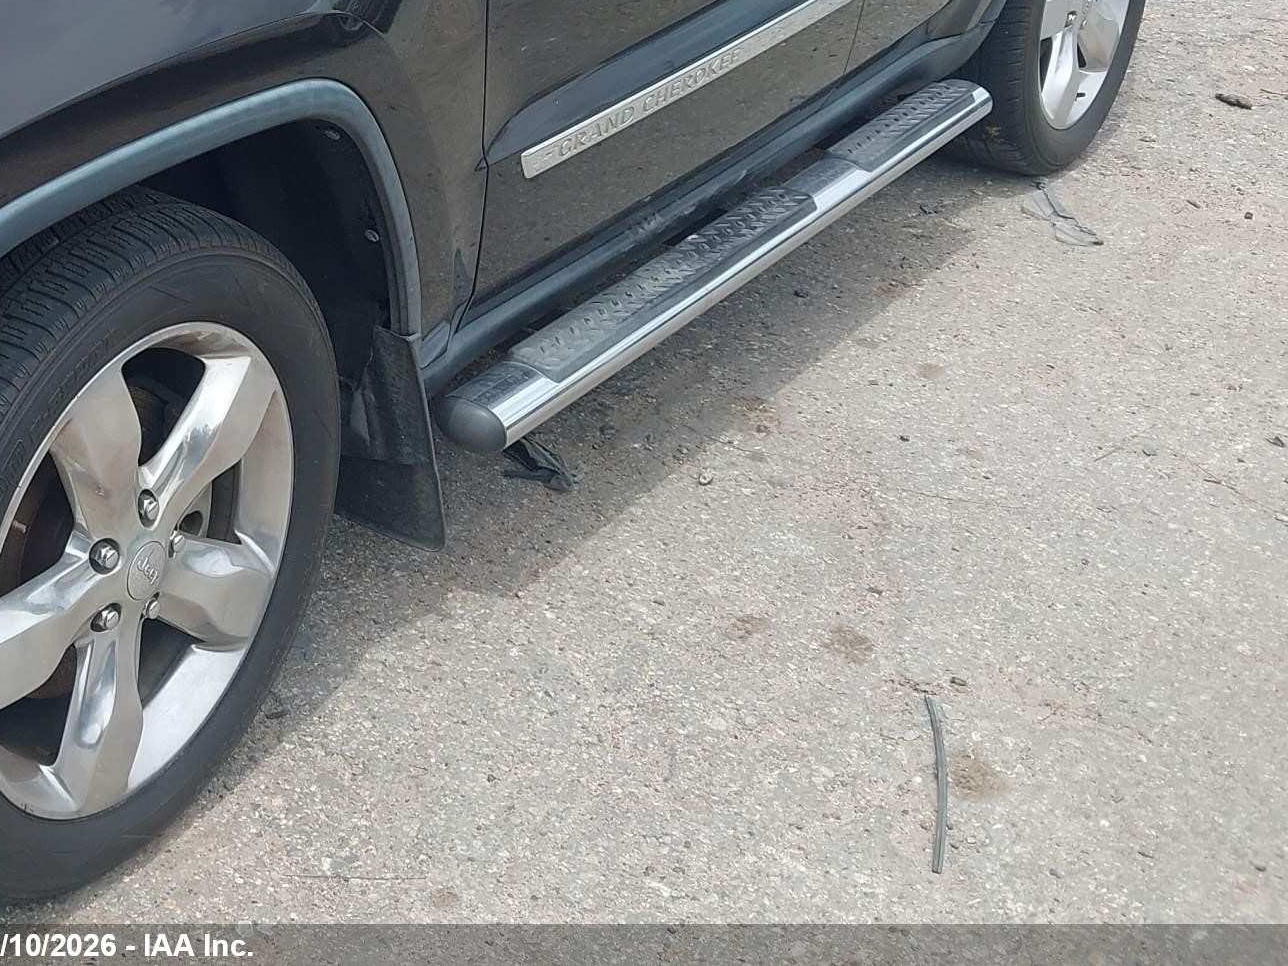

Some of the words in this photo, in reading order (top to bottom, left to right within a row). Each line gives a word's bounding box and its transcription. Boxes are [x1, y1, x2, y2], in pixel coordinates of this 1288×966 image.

[557, 105, 636, 157] GRAND
[642, 48, 743, 113] CHEROKEE
[136, 556, 159, 586] Jeep
